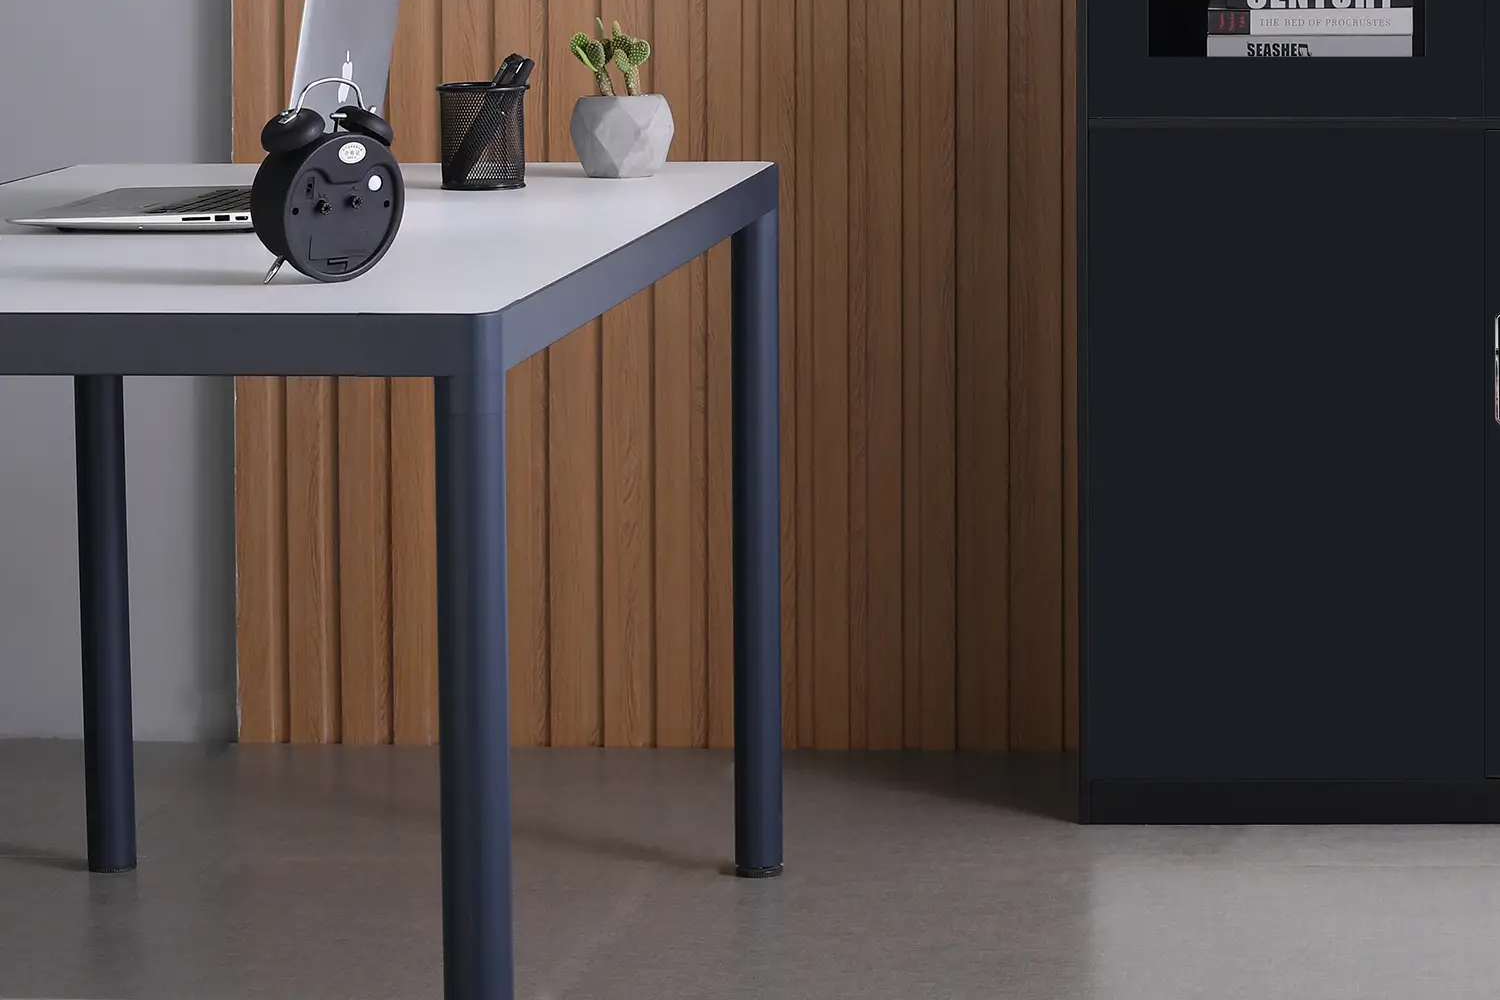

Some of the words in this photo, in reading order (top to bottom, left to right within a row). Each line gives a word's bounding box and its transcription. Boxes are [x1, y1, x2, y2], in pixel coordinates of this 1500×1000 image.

[1259, 18, 1280, 27] THE
[1284, 18, 1305, 27] BED
[1308, 18, 1323, 27] OF
[1325, 18, 1392, 27] PROCRUSTES
